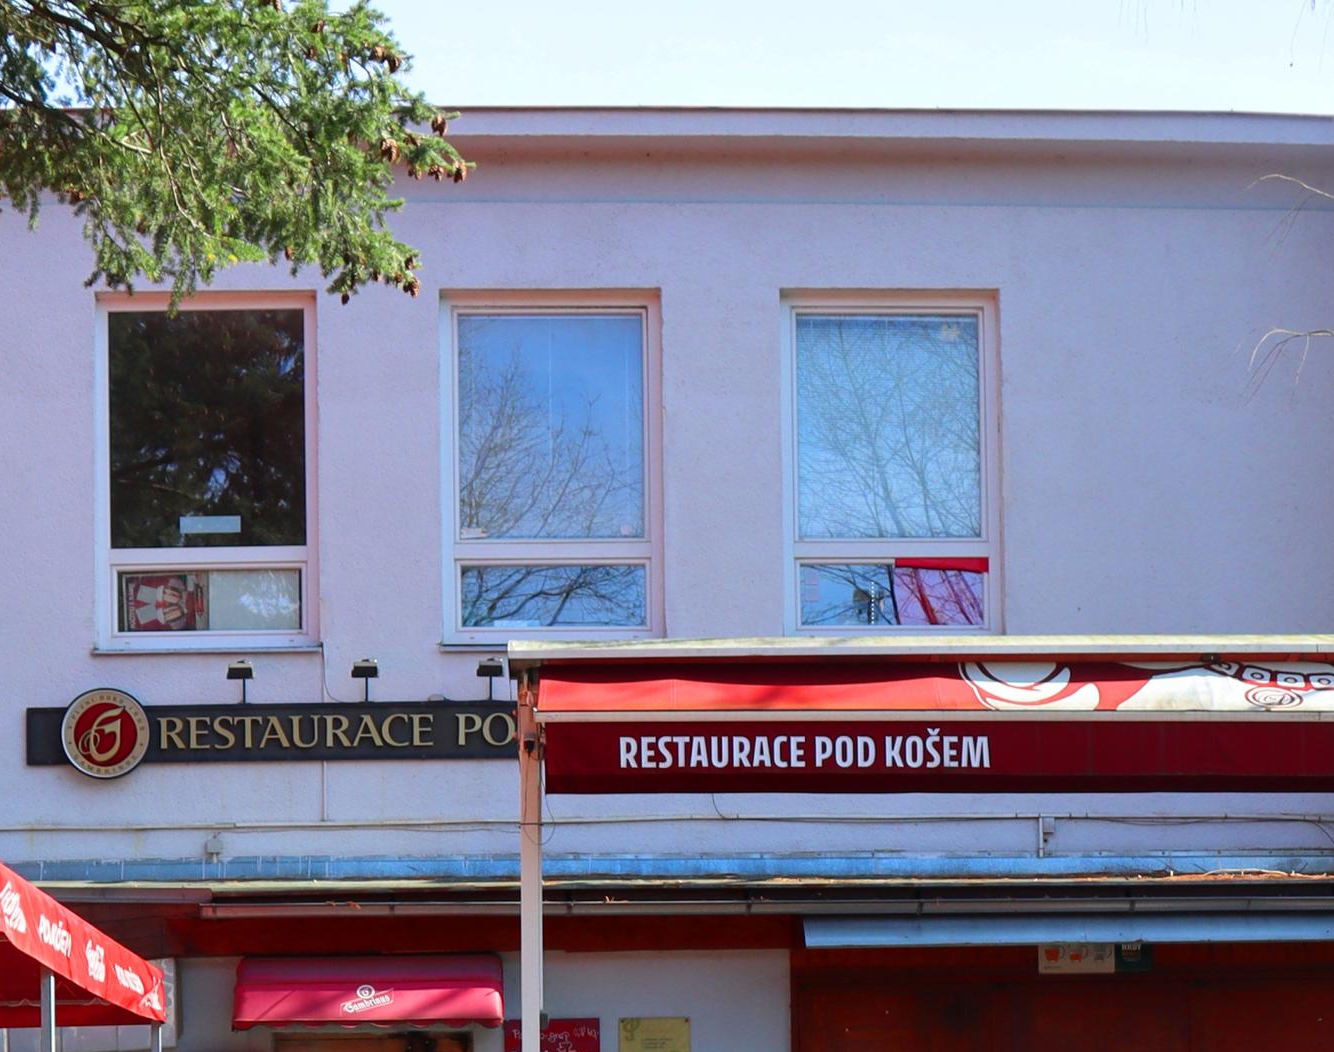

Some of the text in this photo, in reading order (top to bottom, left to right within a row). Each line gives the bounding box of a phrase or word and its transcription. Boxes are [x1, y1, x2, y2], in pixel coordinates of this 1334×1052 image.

[157, 711, 517, 750] RESTAURACE PO
[619, 728, 991, 769] RESTAURACE POD KOŠEM
[342, 993, 391, 1014] Gambrinus
